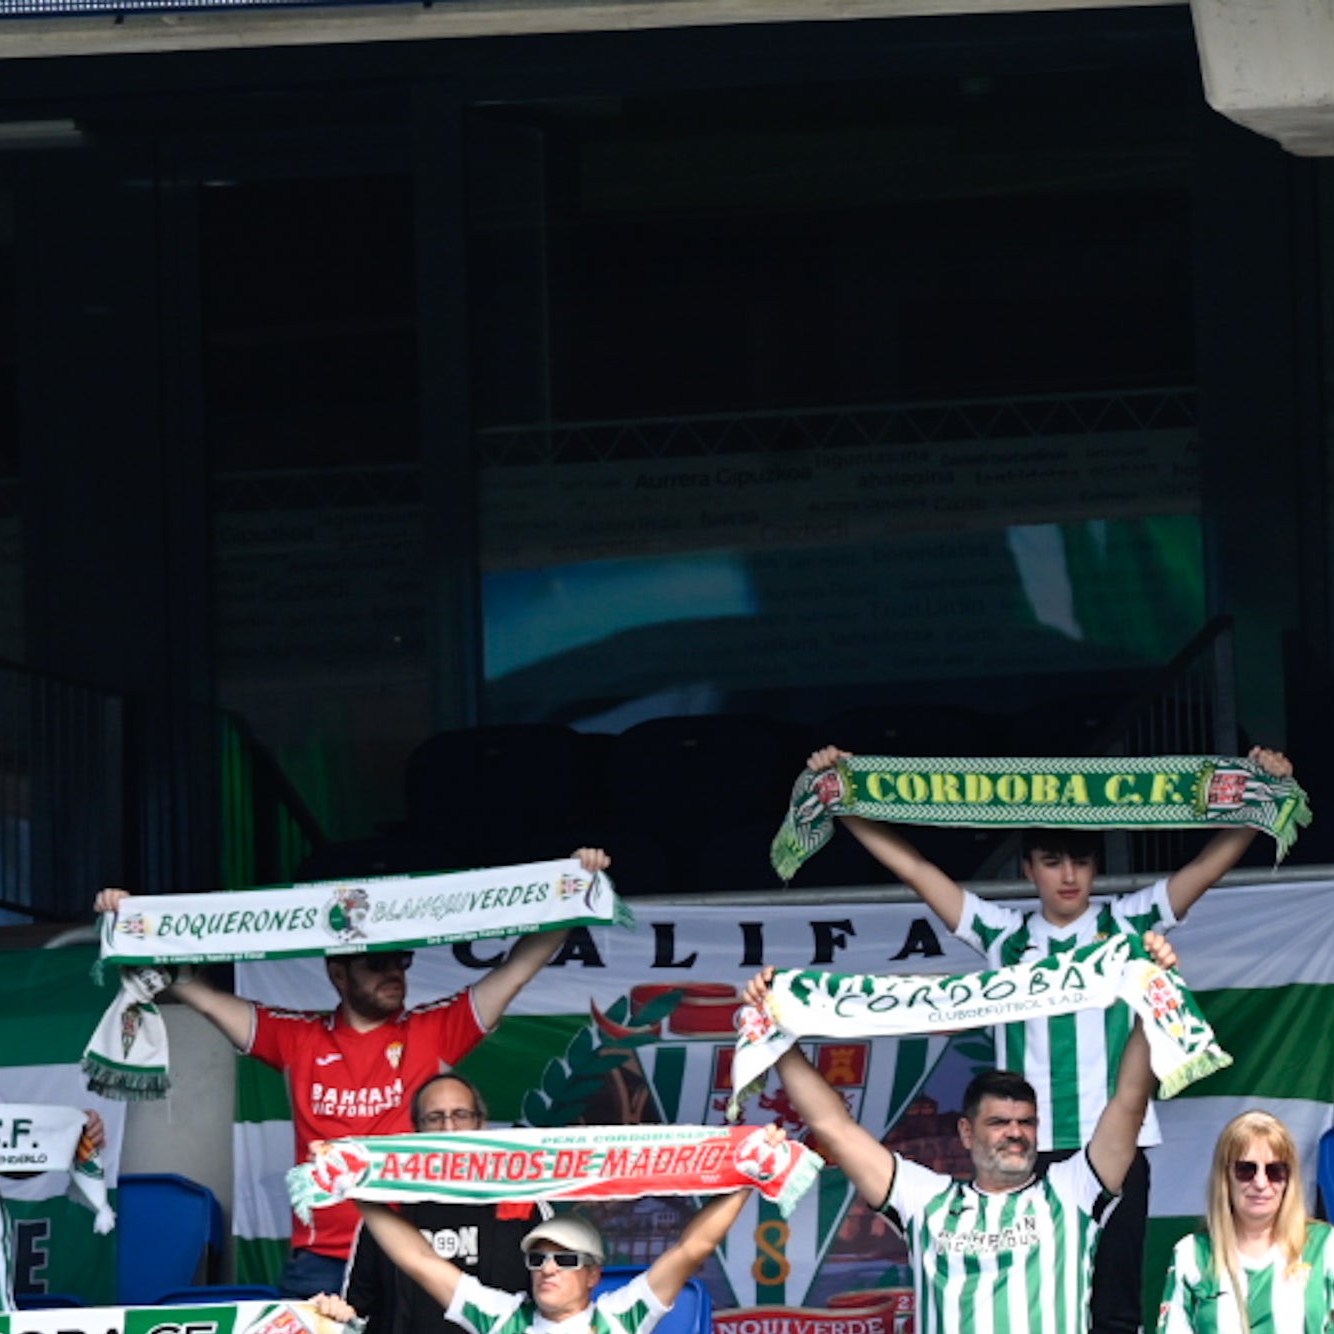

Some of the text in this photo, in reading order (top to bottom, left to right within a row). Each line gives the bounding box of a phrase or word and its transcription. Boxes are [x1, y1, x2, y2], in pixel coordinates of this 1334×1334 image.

[156, 883, 551, 939] BOQUERONES BLANQUIVERDES
[380, 1143, 727, 1182] A4CIENTOS DE MADRID
